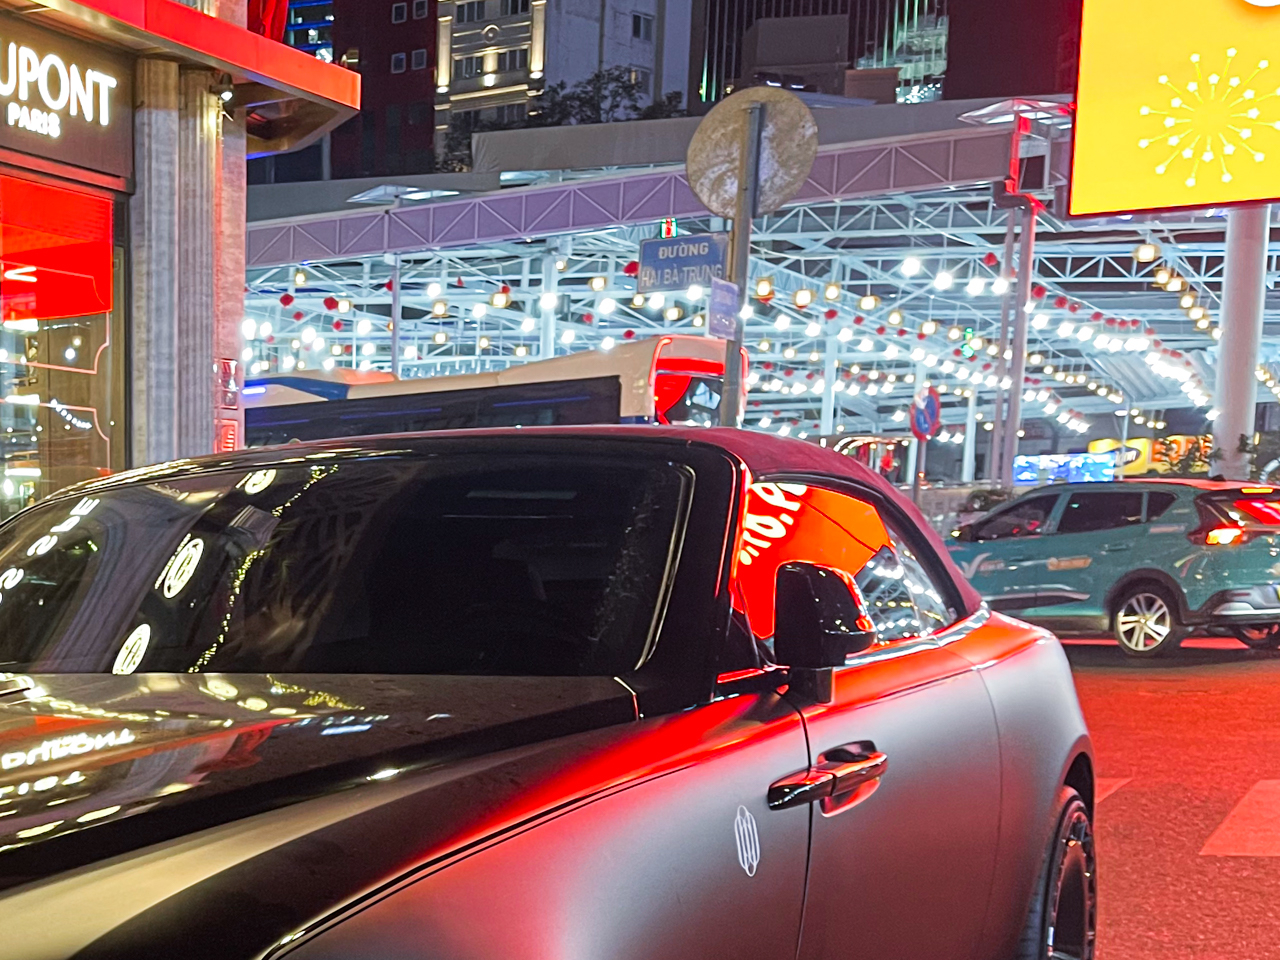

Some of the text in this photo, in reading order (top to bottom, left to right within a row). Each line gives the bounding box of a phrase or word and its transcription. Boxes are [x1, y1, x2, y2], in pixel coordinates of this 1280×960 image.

[7, 102, 61, 138] PARIS
[641, 268, 660, 287] HAI
[664, 263, 679, 284] BÀ
